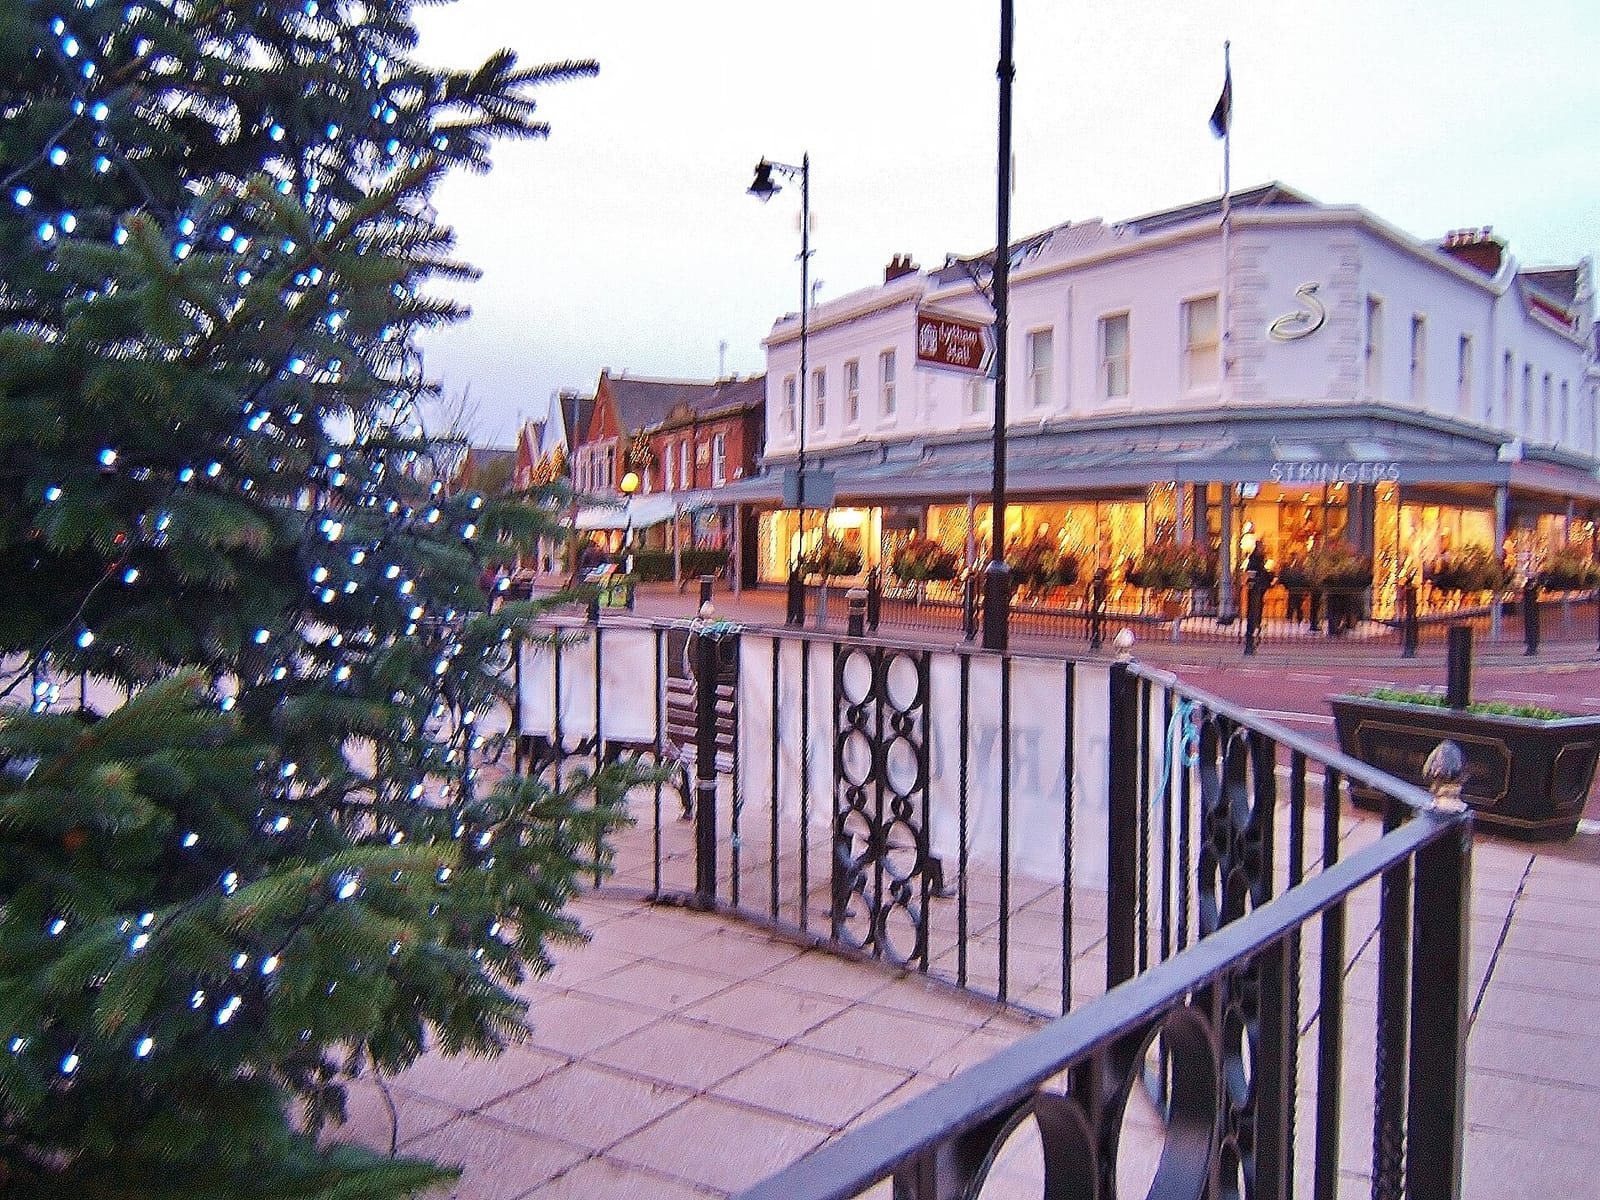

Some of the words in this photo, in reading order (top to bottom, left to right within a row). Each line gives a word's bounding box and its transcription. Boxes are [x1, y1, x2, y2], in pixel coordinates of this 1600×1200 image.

[939, 322, 978, 346] Lytham
[946, 342, 971, 365] Hall
[1270, 462, 1400, 483] STRINGERS
